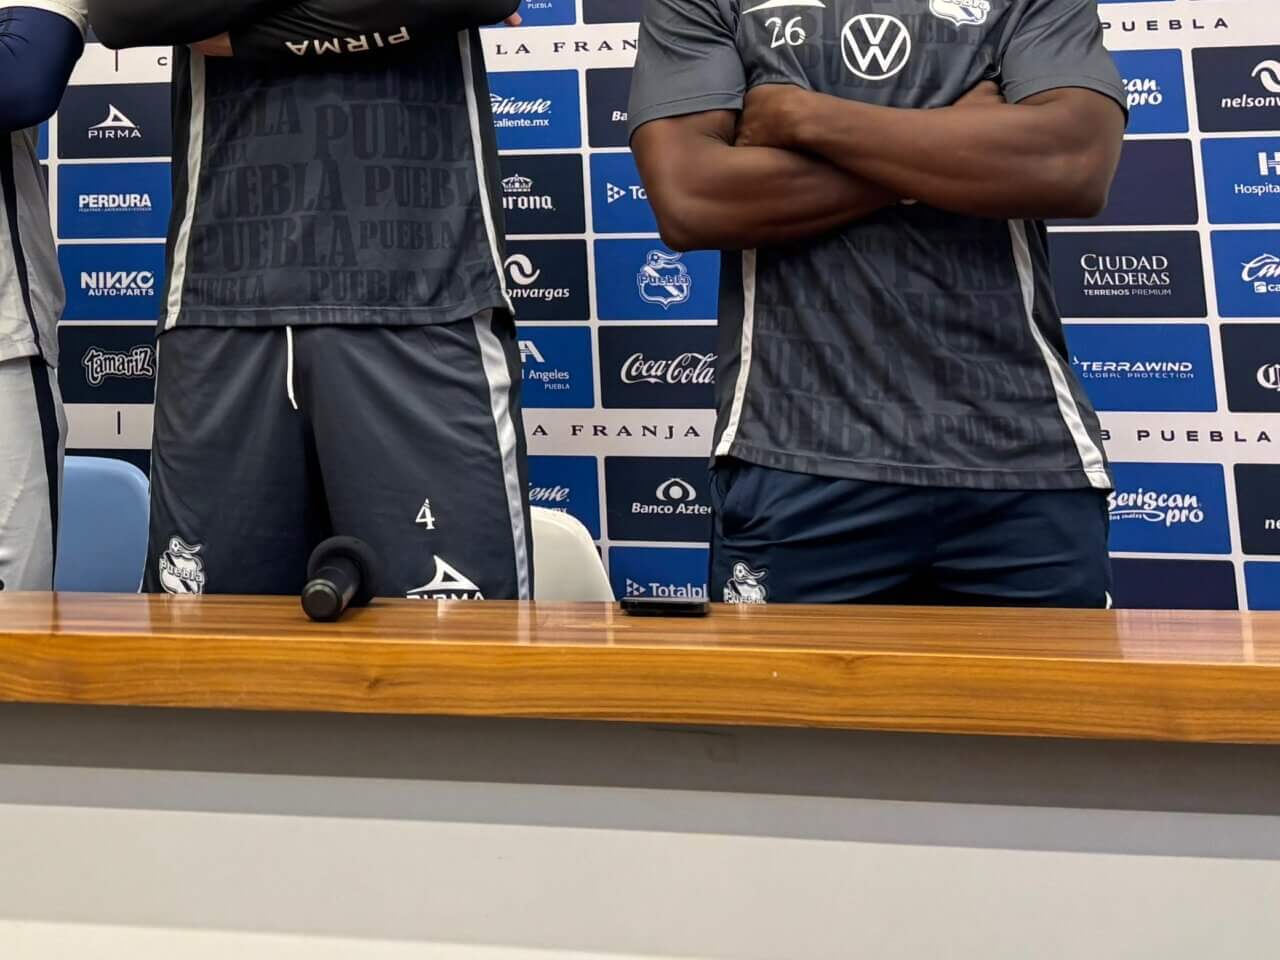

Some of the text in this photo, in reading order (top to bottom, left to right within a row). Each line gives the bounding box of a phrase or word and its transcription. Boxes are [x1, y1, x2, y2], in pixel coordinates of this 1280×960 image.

[765, 16, 806, 49] 26
[285, 25, 411, 56] PIRMA
[496, 38, 638, 55] LA FRAN
[490, 97, 552, 116] aliente
[87, 127, 142, 139] PIRMA
[1234, 182, 1280, 196] Hospita
[78, 193, 152, 208] PERDURA
[1080, 254, 1168, 271] CIUDAD
[81, 270, 154, 289] NIKKO
[1082, 270, 1171, 286] MADERAS
[87, 288, 154, 297] AUTO-PARTS
[505, 286, 570, 301] onvargas
[1131, 288, 1172, 296] PREMIUM
[620, 352, 717, 384] Coca-Cola
[1080, 361, 1193, 372] TERRAWIND
[528, 370, 570, 382] Angeles
[1126, 371, 1194, 379] PROTECTION
[532, 425, 701, 440] A FRANJA
[1137, 429, 1272, 442] PUEBLA
[414, 498, 436, 530] 4
[631, 501, 712, 515] Banco Azte
[1166, 508, 1204, 528] pro
